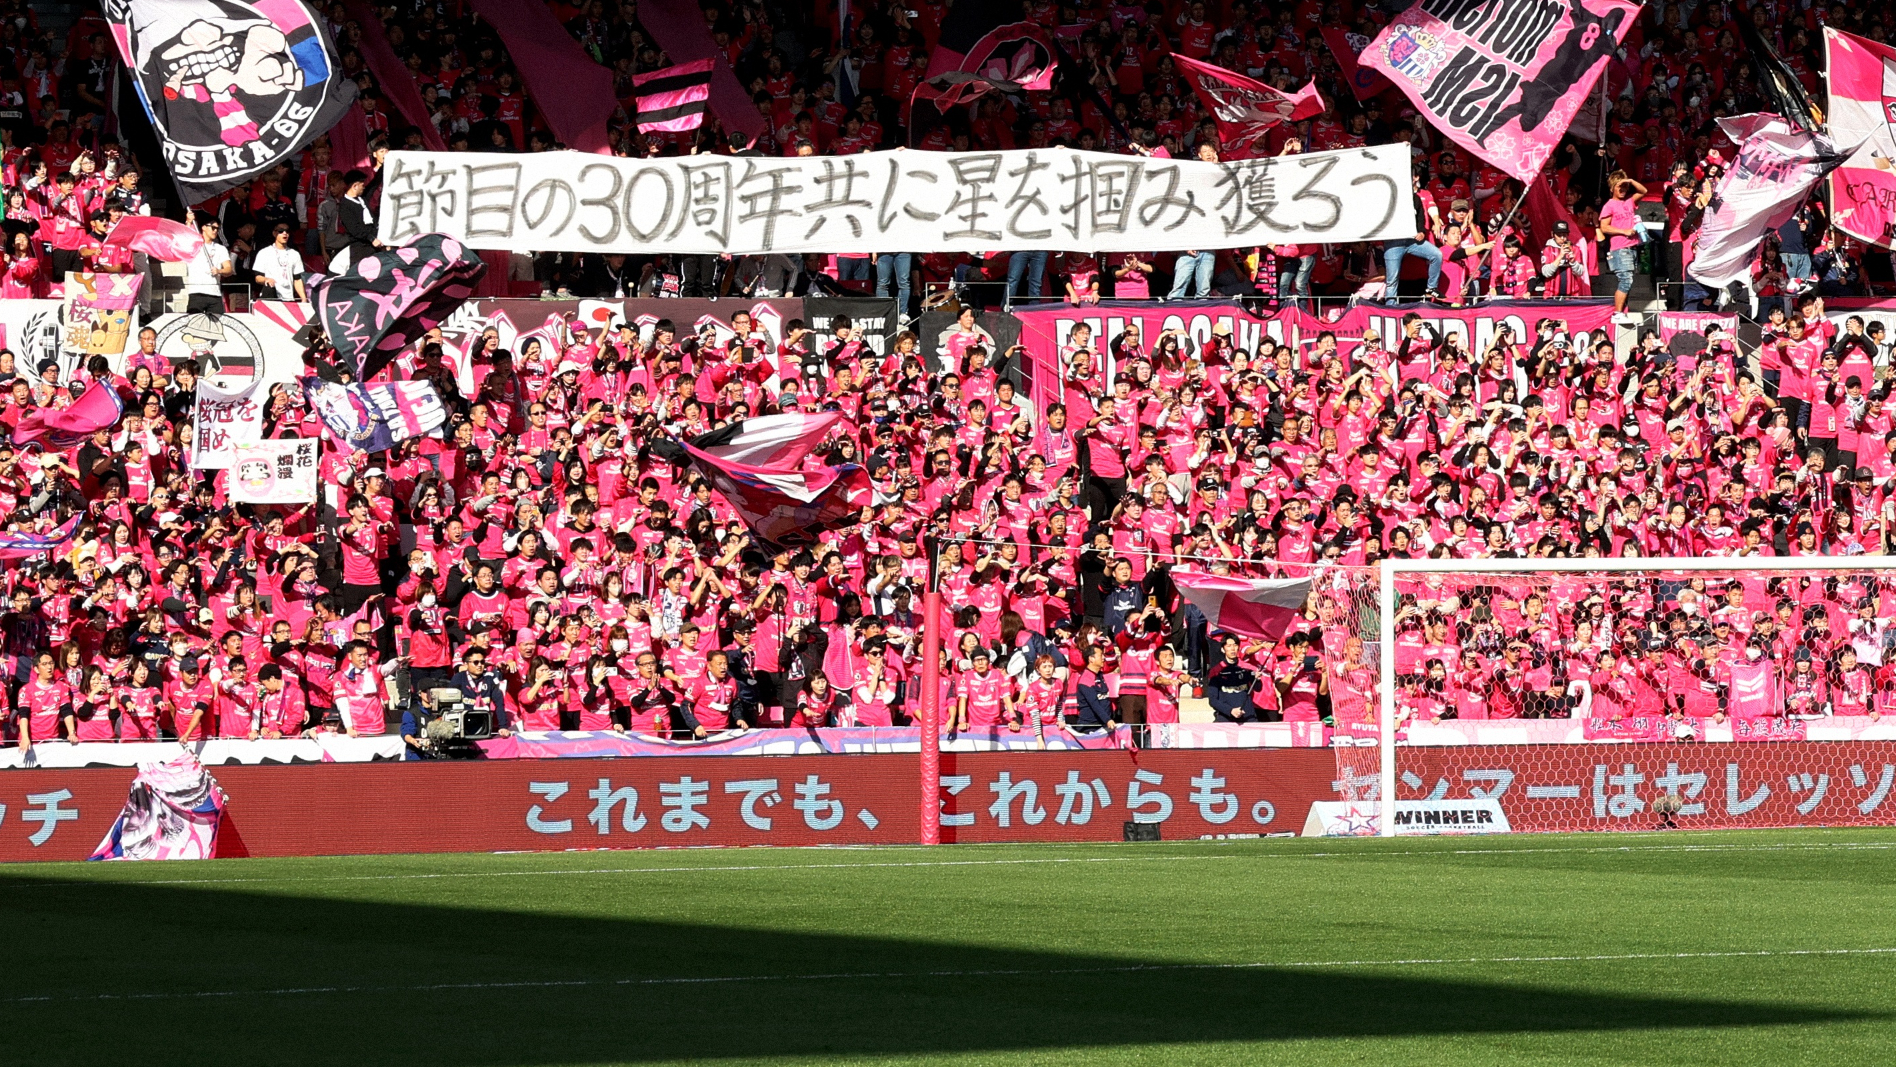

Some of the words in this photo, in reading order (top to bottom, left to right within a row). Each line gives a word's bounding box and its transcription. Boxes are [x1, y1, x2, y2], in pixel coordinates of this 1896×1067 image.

[1678, 317, 1698, 331] ARE
[1351, 722, 1379, 732] RYUYA
[0, 788, 79, 847] チ
